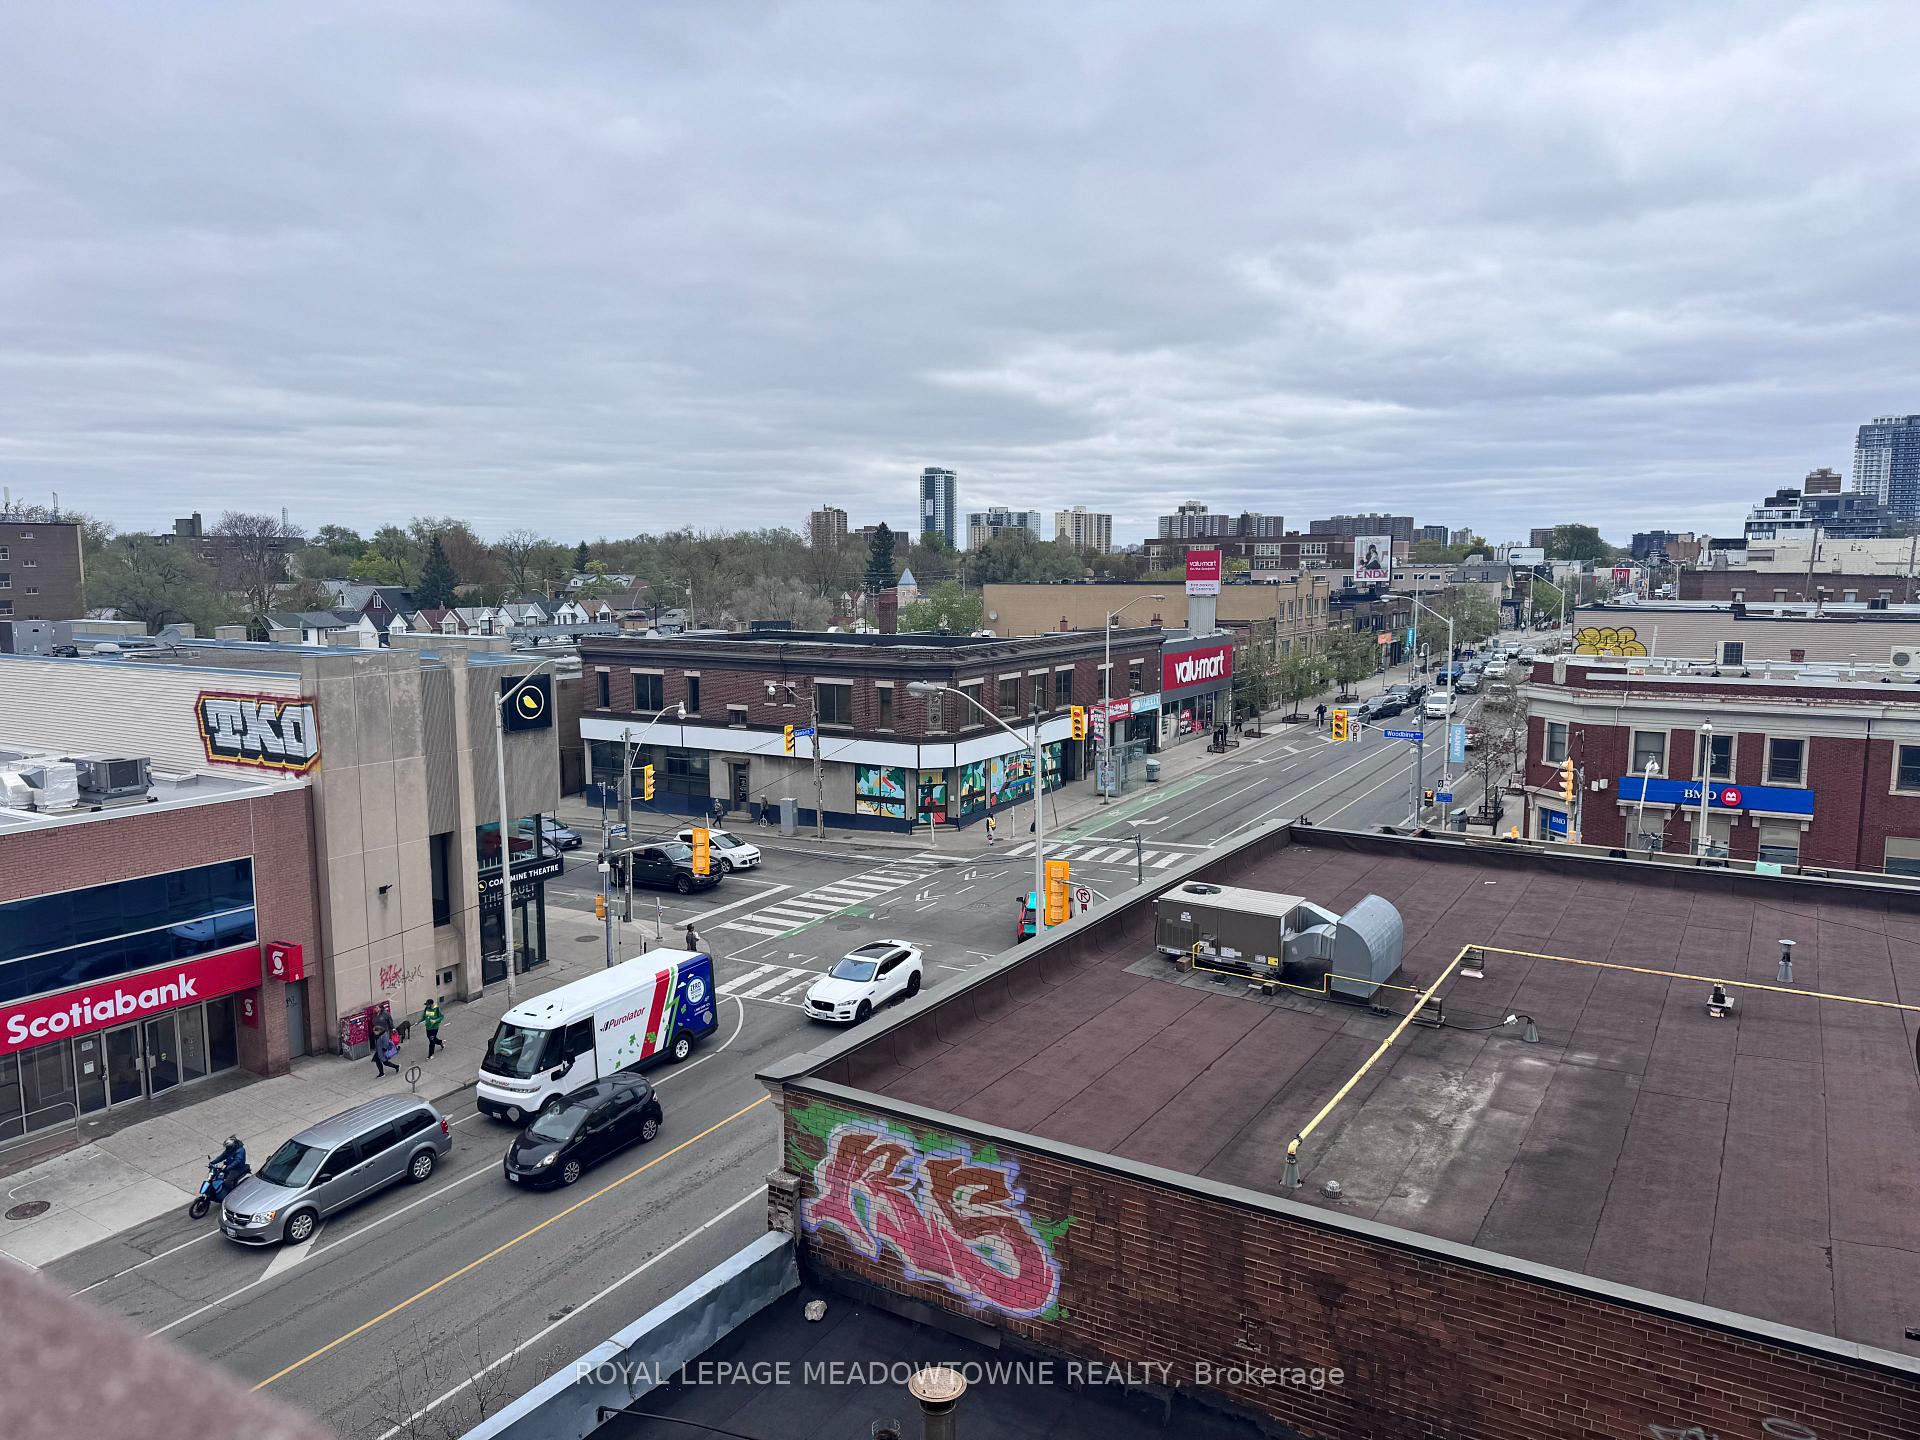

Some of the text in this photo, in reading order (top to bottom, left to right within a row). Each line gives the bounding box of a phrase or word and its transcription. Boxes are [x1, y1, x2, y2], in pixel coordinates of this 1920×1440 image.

[1356, 570, 1388, 579] ENDY
[1684, 788, 1717, 800] BMO
[1552, 816, 1566, 825] BMO
[488, 863, 559, 888] COA MINE THEATRE
[482, 890, 503, 903] THE
[509, 882, 536, 897] AULT
[7, 973, 198, 1044] Scotiabank
[608, 1007, 646, 1029] Purolator
